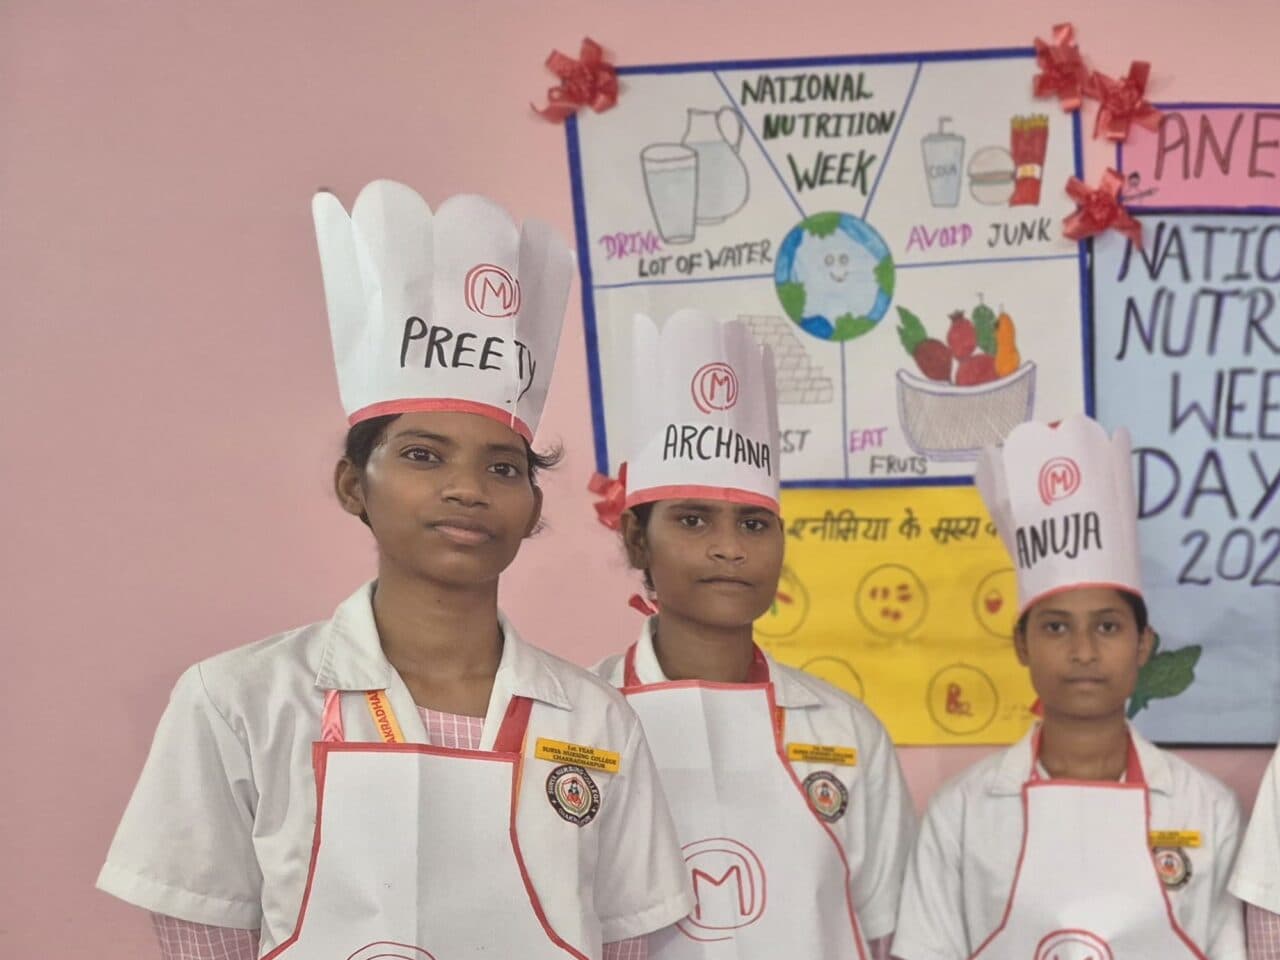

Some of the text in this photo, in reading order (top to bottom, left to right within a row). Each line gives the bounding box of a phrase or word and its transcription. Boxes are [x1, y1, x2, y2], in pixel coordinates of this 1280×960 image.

[740, 73, 873, 105] NATIONAL
[762, 110, 896, 139] NUTRITION
[787, 150, 877, 196] WEEK
[601, 232, 663, 260] DRINK
[906, 218, 1053, 252] AVOID JUNK
[638, 240, 774, 278] LOT OF WATER
[400, 316, 536, 402] PREETY
[663, 423, 772, 475] ARCHANA
[850, 426, 888, 453] EAT
[1016, 511, 1103, 569] ANUJA
